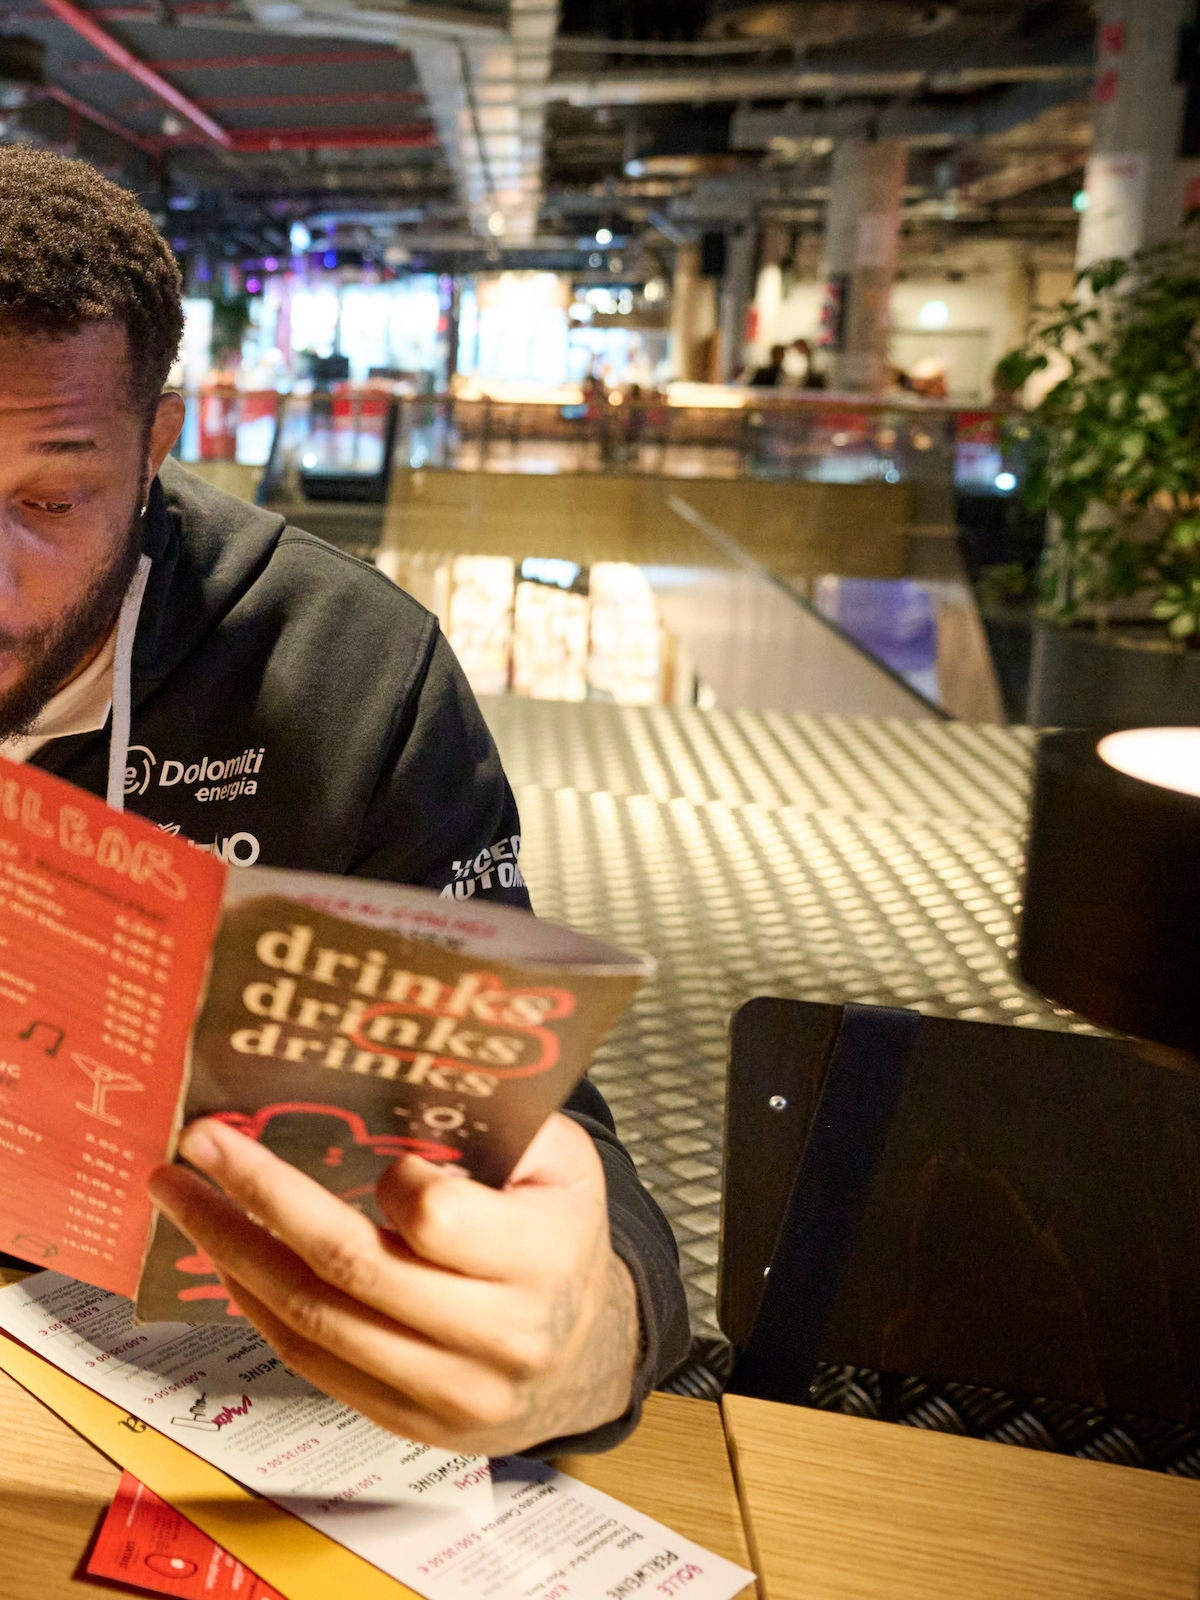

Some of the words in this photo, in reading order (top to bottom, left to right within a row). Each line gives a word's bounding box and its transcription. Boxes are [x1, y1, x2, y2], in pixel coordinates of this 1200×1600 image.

[159, 748, 265, 786] Dolomiti
[195, 777, 257, 802] energia
[256, 924, 551, 1025] drinks
[243, 978, 524, 1064] drinks
[230, 1023, 498, 1097] drinks
[220, 1341, 263, 1362] Lageder
[516, 1485, 558, 1510] Mercato
[600, 1548, 683, 1600] PERLWEINE
[651, 1561, 706, 1596] BOLLE
